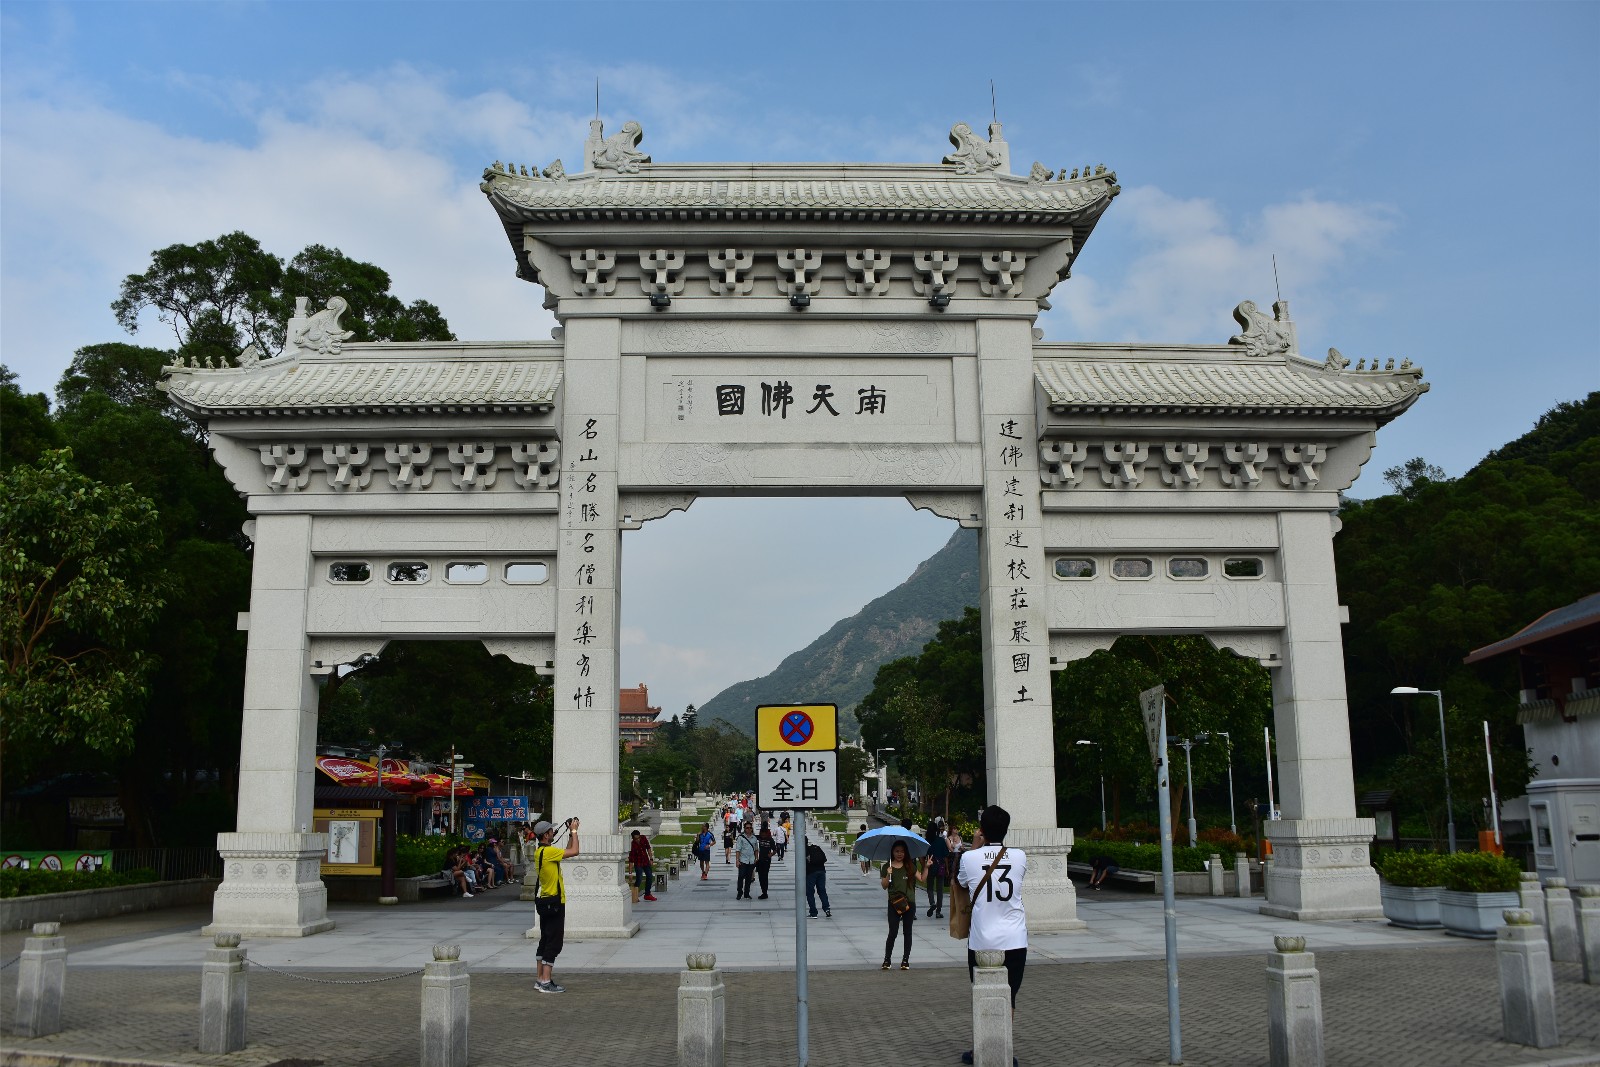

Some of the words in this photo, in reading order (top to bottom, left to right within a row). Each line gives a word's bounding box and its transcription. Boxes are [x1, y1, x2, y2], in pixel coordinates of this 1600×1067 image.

[767, 757, 792, 773] 24
[797, 757, 826, 773] hrs
[772, 778, 818, 802] 全日
[982, 865, 1014, 902] 13
